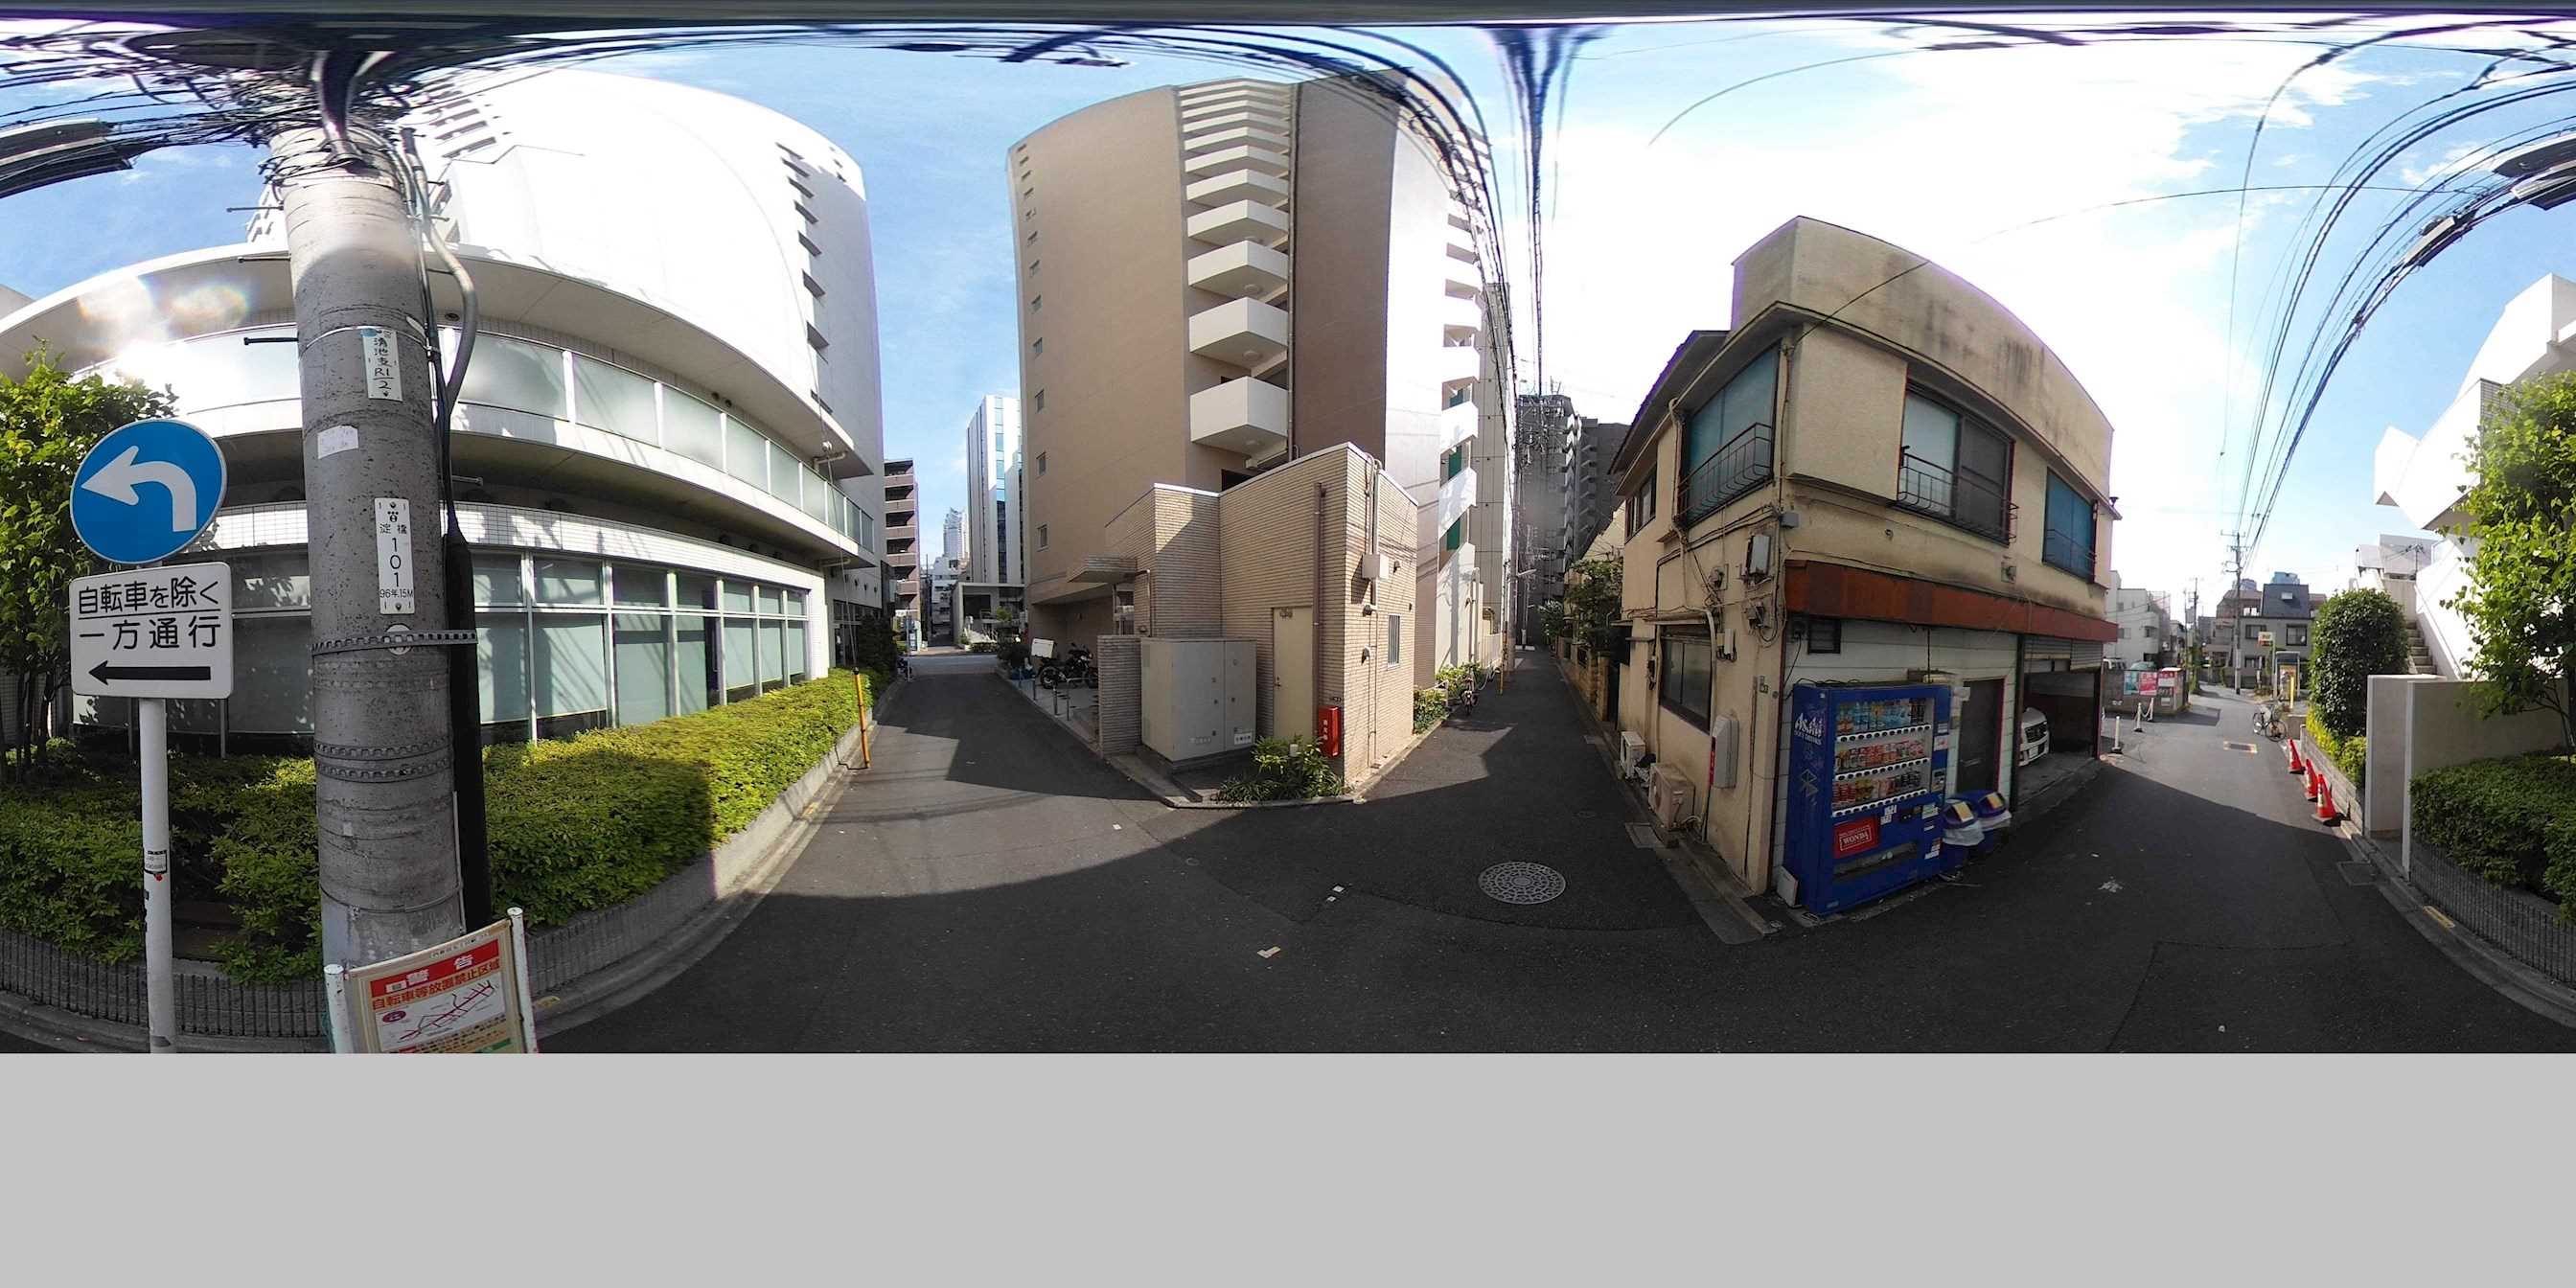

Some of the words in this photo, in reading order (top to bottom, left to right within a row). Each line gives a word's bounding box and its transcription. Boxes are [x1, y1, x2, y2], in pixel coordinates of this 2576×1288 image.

[389, 537, 402, 587] 101
[79, 576, 218, 614] 自転車を除く
[79, 615, 221, 651] 一方通行
